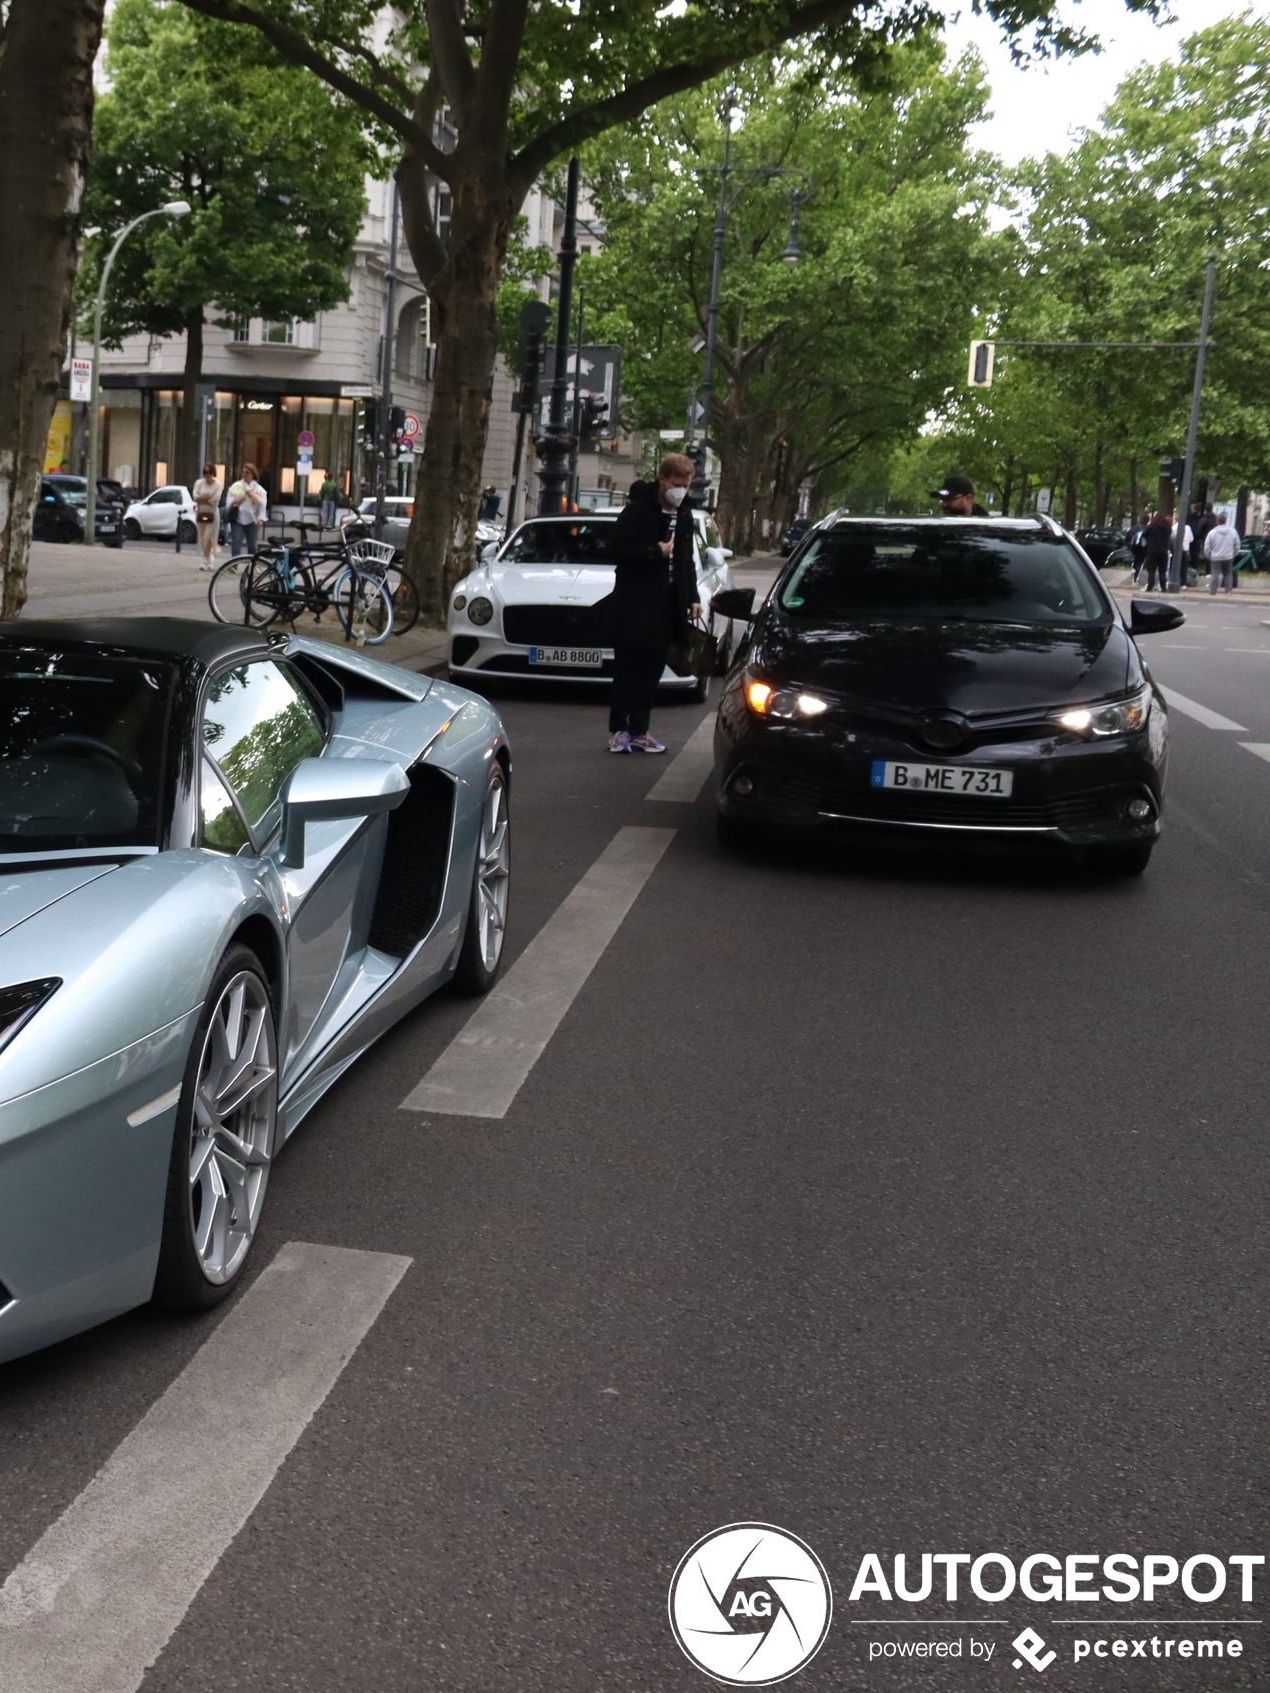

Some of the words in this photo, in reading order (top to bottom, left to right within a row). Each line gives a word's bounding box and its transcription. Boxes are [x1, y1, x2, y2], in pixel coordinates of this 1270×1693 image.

[247, 400, 274, 411] Cartier
[404, 421, 415, 432] 30
[537, 649, 545, 660] B
[552, 650, 568, 662] AB
[570, 651, 599, 663] 8800
[893, 765, 908, 786] B
[924, 767, 955, 790] ME
[961, 770, 1004, 793] 731
